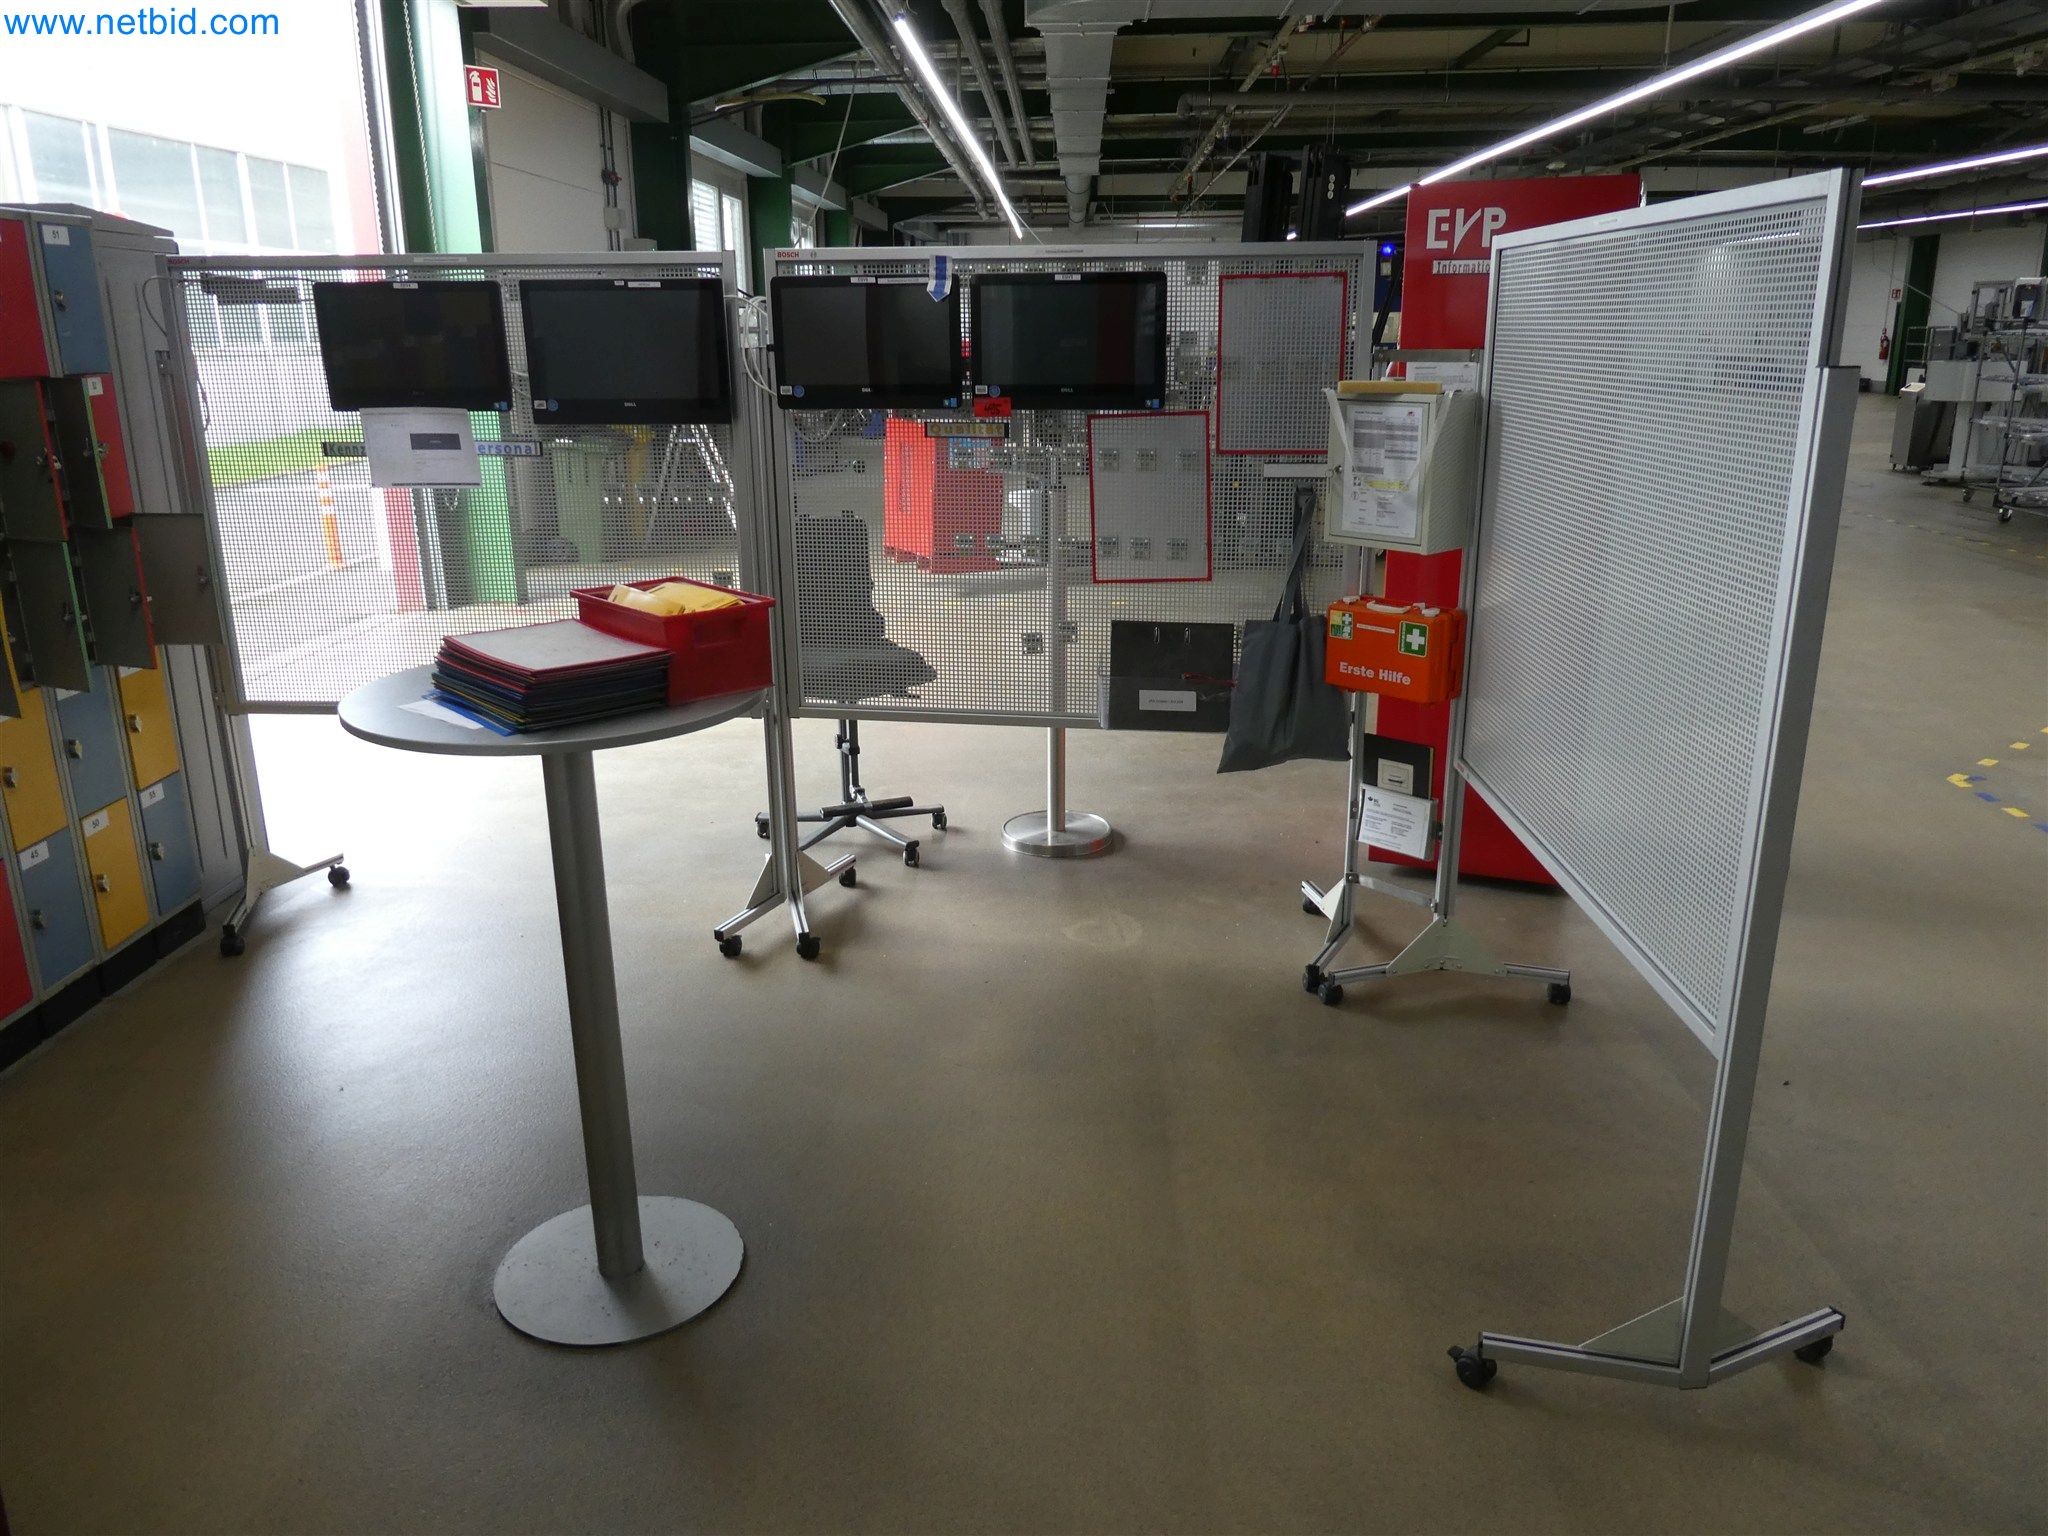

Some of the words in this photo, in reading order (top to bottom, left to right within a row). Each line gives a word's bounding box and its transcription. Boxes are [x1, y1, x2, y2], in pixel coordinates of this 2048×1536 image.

[52, 229, 60, 240] 51
[1426, 207, 1506, 255] EVP
[1436, 261, 1490, 274] Informatio
[329, 443, 367, 455] Kennz
[1339, 662, 1375, 679] Erste
[1378, 668, 1412, 685] Hilfe
[30, 850, 40, 859] 45
